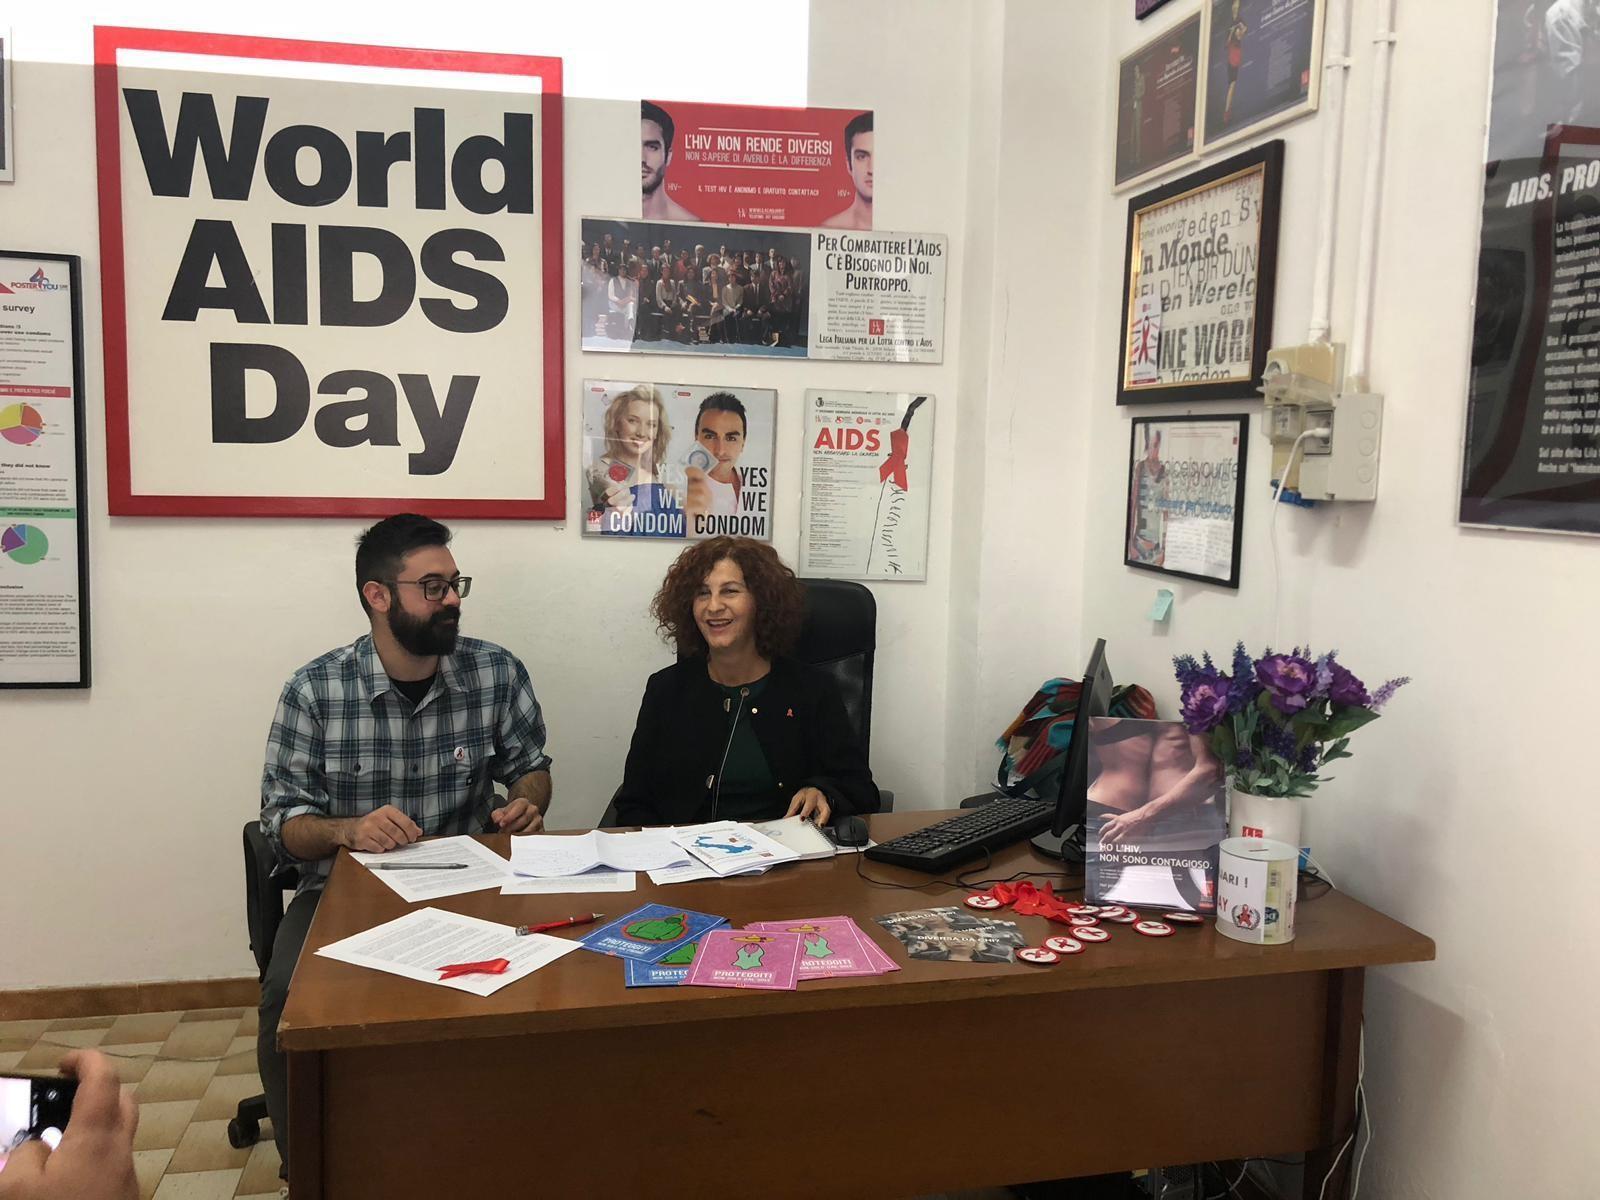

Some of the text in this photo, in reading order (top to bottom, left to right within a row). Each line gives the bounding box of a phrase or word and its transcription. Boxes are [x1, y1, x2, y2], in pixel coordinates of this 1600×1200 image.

[122, 87, 534, 215] World
[685, 134, 832, 156] L'HIV NON RENDE DIVERSI
[685, 151, 700, 161] NON
[702, 152, 729, 163] SAPERE
[732, 153, 740, 163] DI
[743, 154, 768, 165] AVERLO
[779, 156, 788, 165] LA
[791, 156, 832, 167] DIFFERENZA
[704, 185, 716, 193] TEST
[718, 185, 727, 193] HIV
[734, 185, 757, 194] ANONIMO
[763, 187, 787, 196] GRATUITO
[1506, 172, 1553, 208] AIDS.
[818, 234, 941, 257] PER COMBATTERE L'AIDS
[1158, 227, 1229, 272] Monde
[826, 253, 933, 275] C'È BISOGNO DI NOI.
[161, 218, 510, 334] AIDS
[846, 273, 911, 293] PURTROPPO.
[3, 305, 35, 314] survey
[819, 334, 833, 344] LEGA
[834, 334, 856, 345] ITALIANA
[858, 337, 868, 345] PER
[878, 336, 893, 346] LOTTA
[209, 342, 482, 476] Day
[813, 427, 881, 452] AIDS
[740, 466, 768, 488] YES
[659, 488, 684, 510] WE
[742, 491, 767, 512] WE
[610, 512, 683, 534] CONDOM
[695, 514, 765, 537] CONDOM
[1099, 843, 1113, 852] HO
[1100, 853, 1214, 870] NON SONO CONTAGIOSO.
[801, 959, 853, 967] ROTEGGITI
